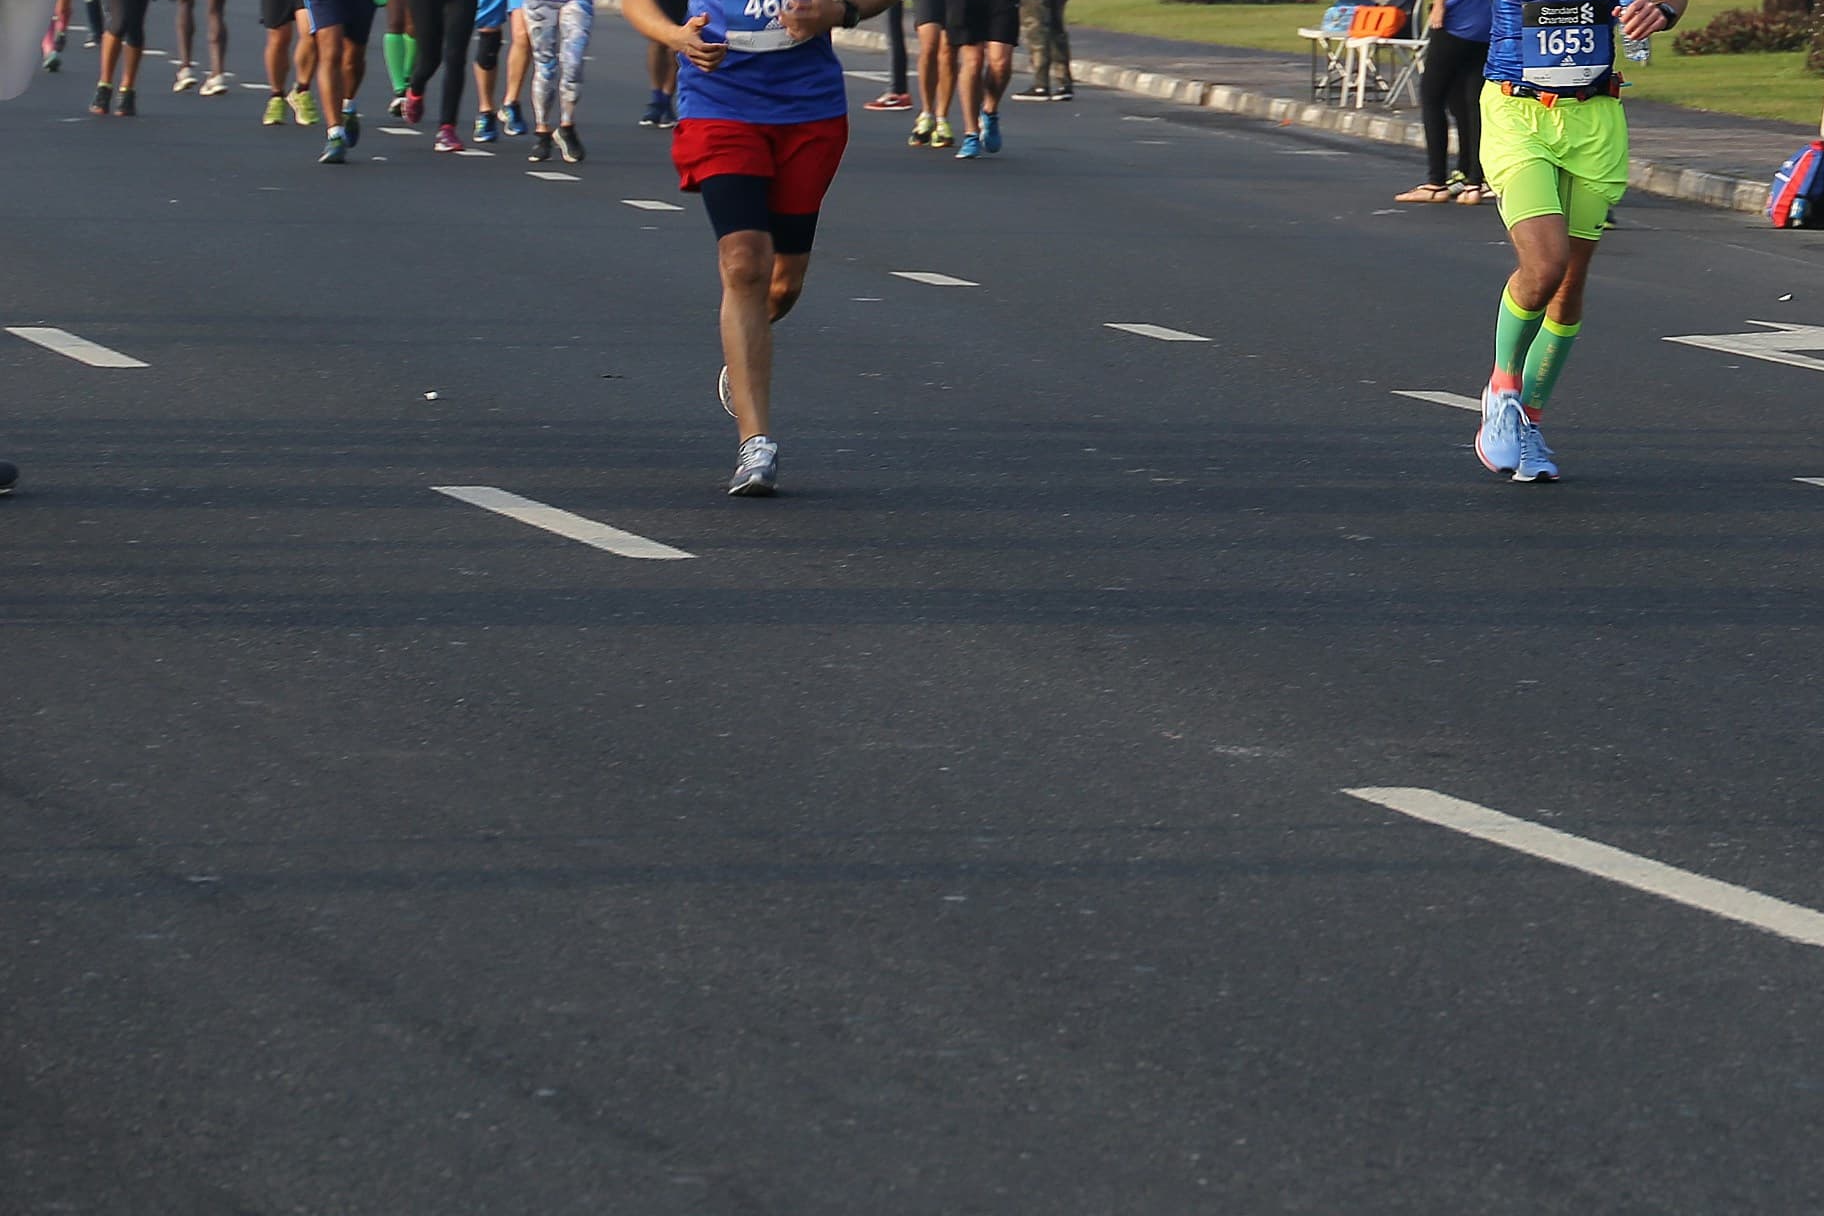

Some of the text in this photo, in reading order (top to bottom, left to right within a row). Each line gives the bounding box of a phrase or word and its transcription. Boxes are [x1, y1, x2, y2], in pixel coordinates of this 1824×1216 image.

[1540, 6, 1579, 16] Standard
[1537, 15, 1579, 25] Chartered
[1536, 27, 1596, 56] 1653
